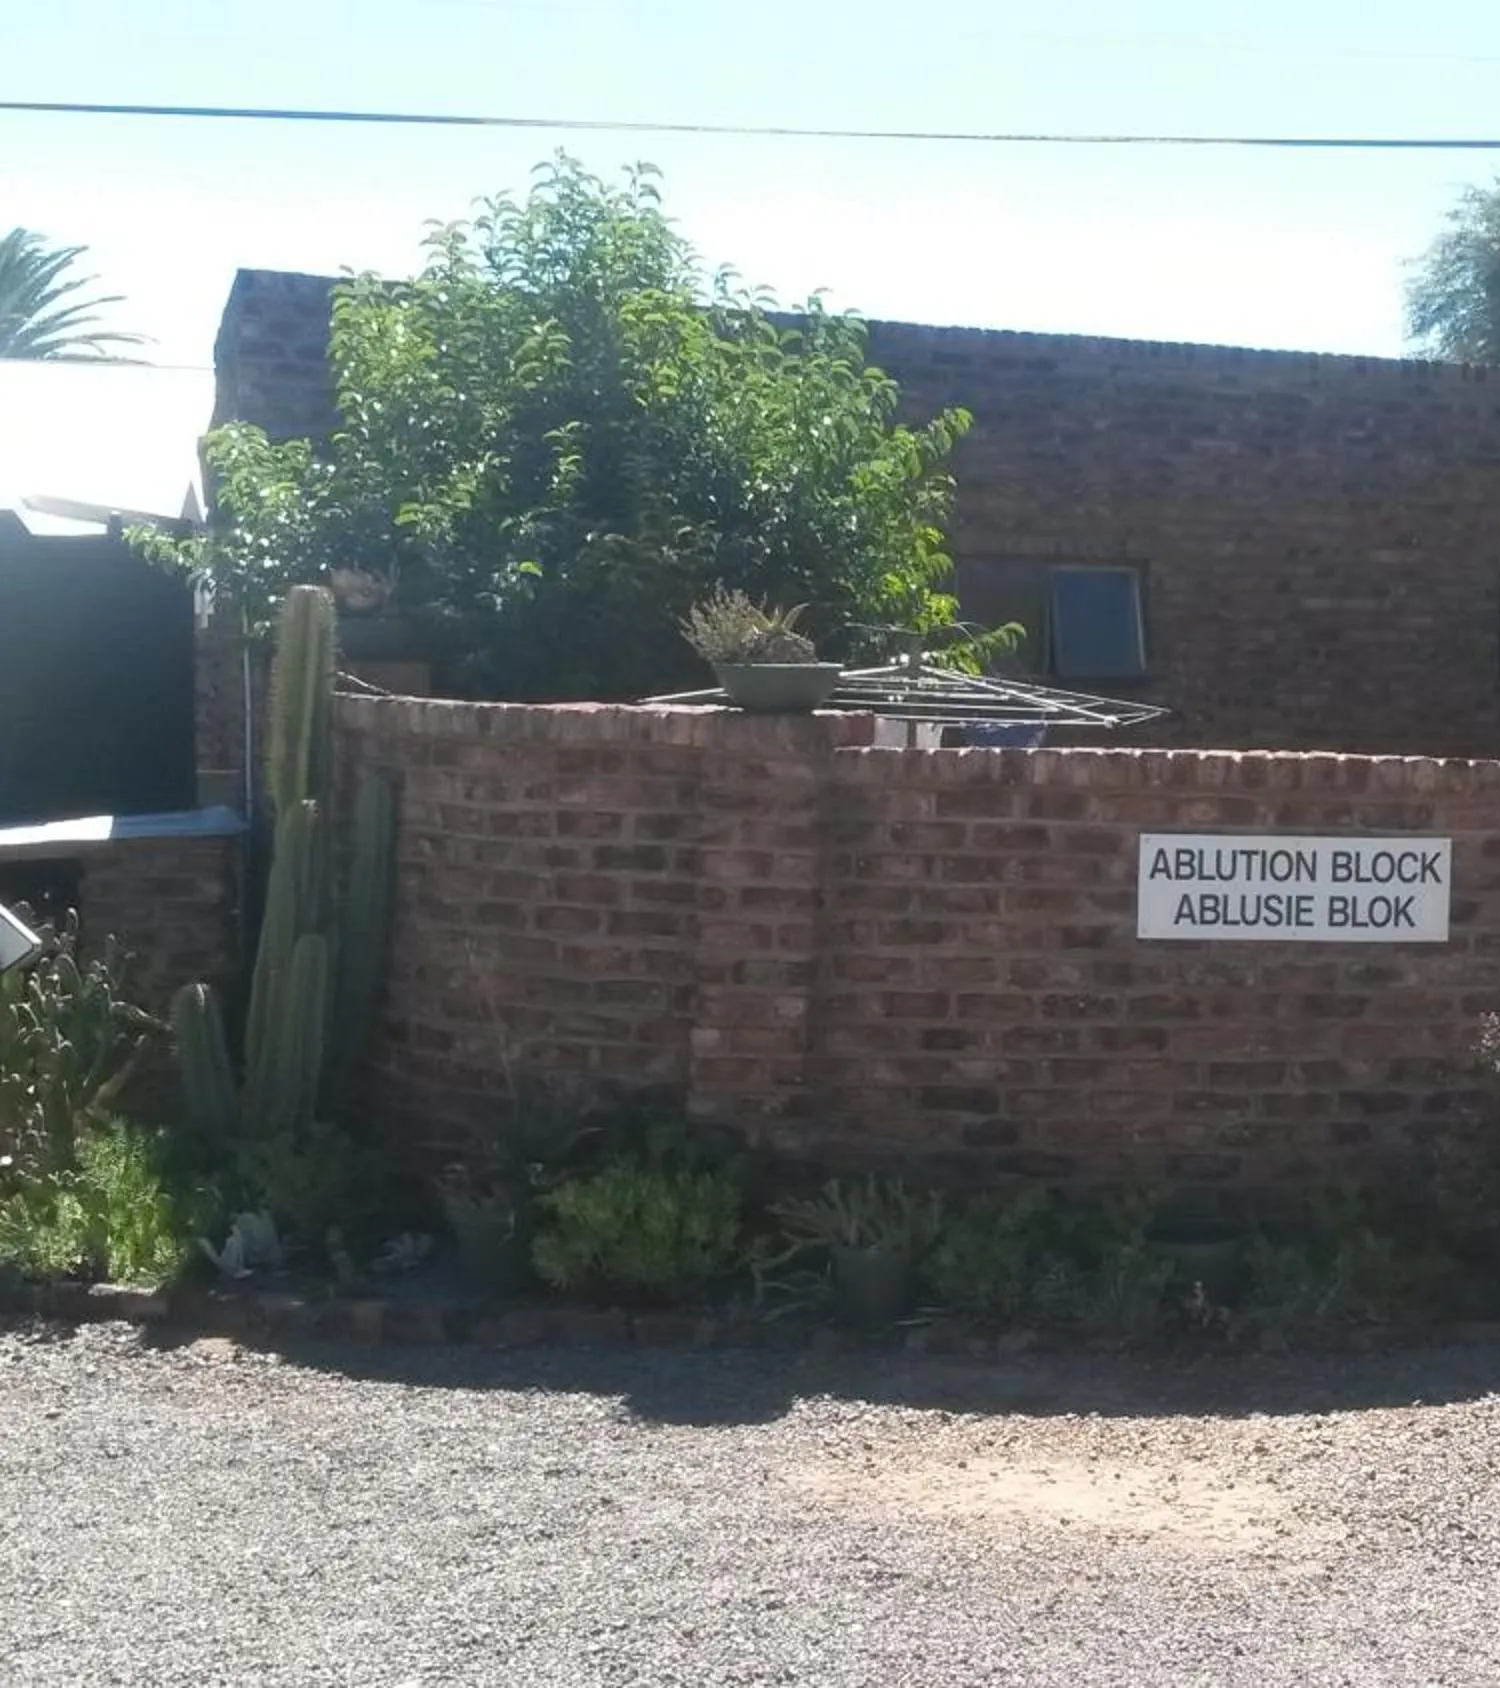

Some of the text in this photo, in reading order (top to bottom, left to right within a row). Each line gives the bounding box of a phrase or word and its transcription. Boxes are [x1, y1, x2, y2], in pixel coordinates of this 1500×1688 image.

[1150, 847, 1442, 884] ABLUTION BLOCK
[1173, 893, 1416, 928] ABLUSIE BLOK
